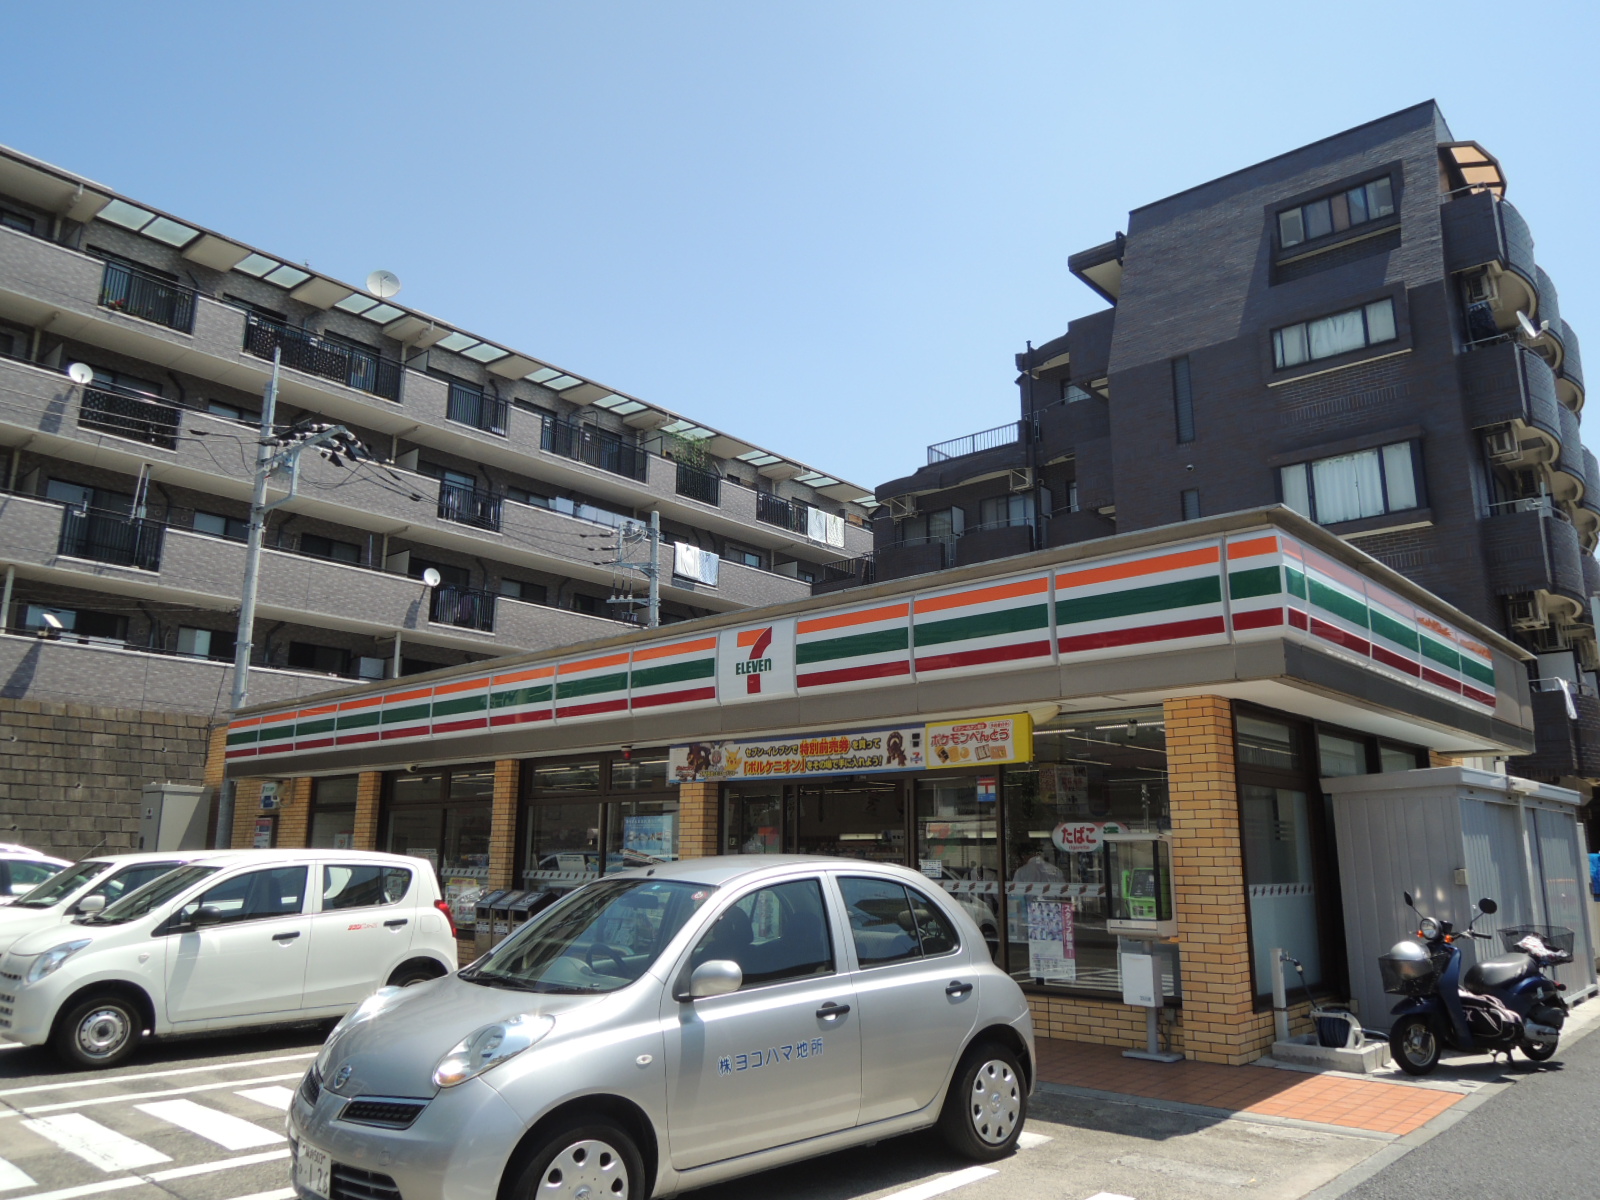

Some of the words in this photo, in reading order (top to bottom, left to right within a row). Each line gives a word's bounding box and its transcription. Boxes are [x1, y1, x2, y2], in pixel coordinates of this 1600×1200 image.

[737, 626, 772, 694] 7
[931, 728, 1010, 746] ポケモンべんとう
[1062, 826, 1097, 844] たばこ
